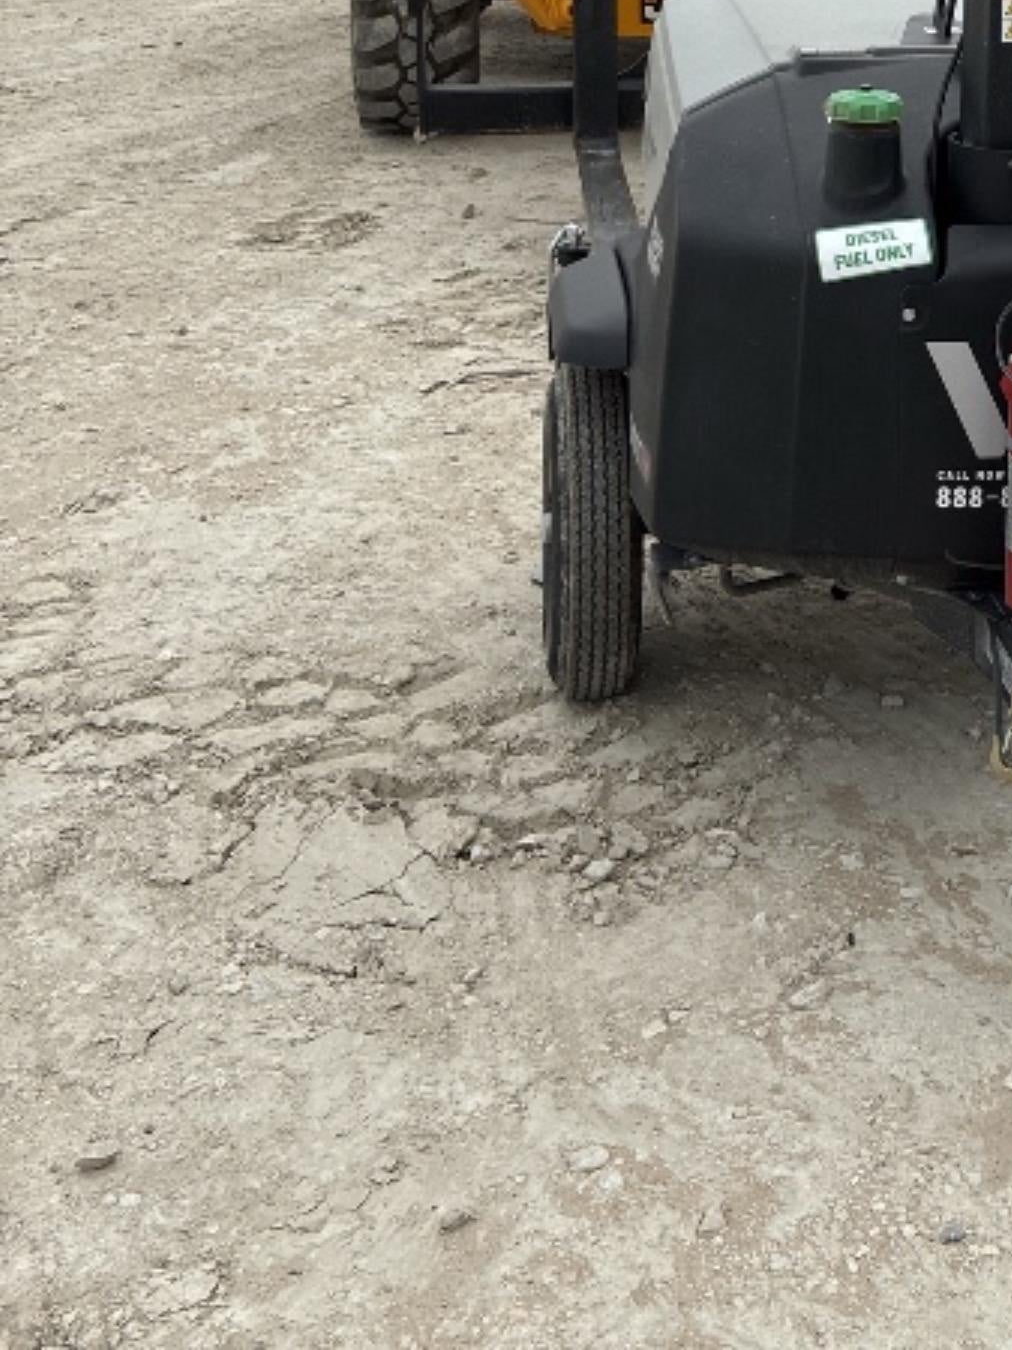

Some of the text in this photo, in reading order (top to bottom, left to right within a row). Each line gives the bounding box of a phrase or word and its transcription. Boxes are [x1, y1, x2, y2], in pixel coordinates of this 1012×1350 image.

[844, 229, 898, 247] DIESEL
[834, 242, 914, 270] FUEL ONLY
